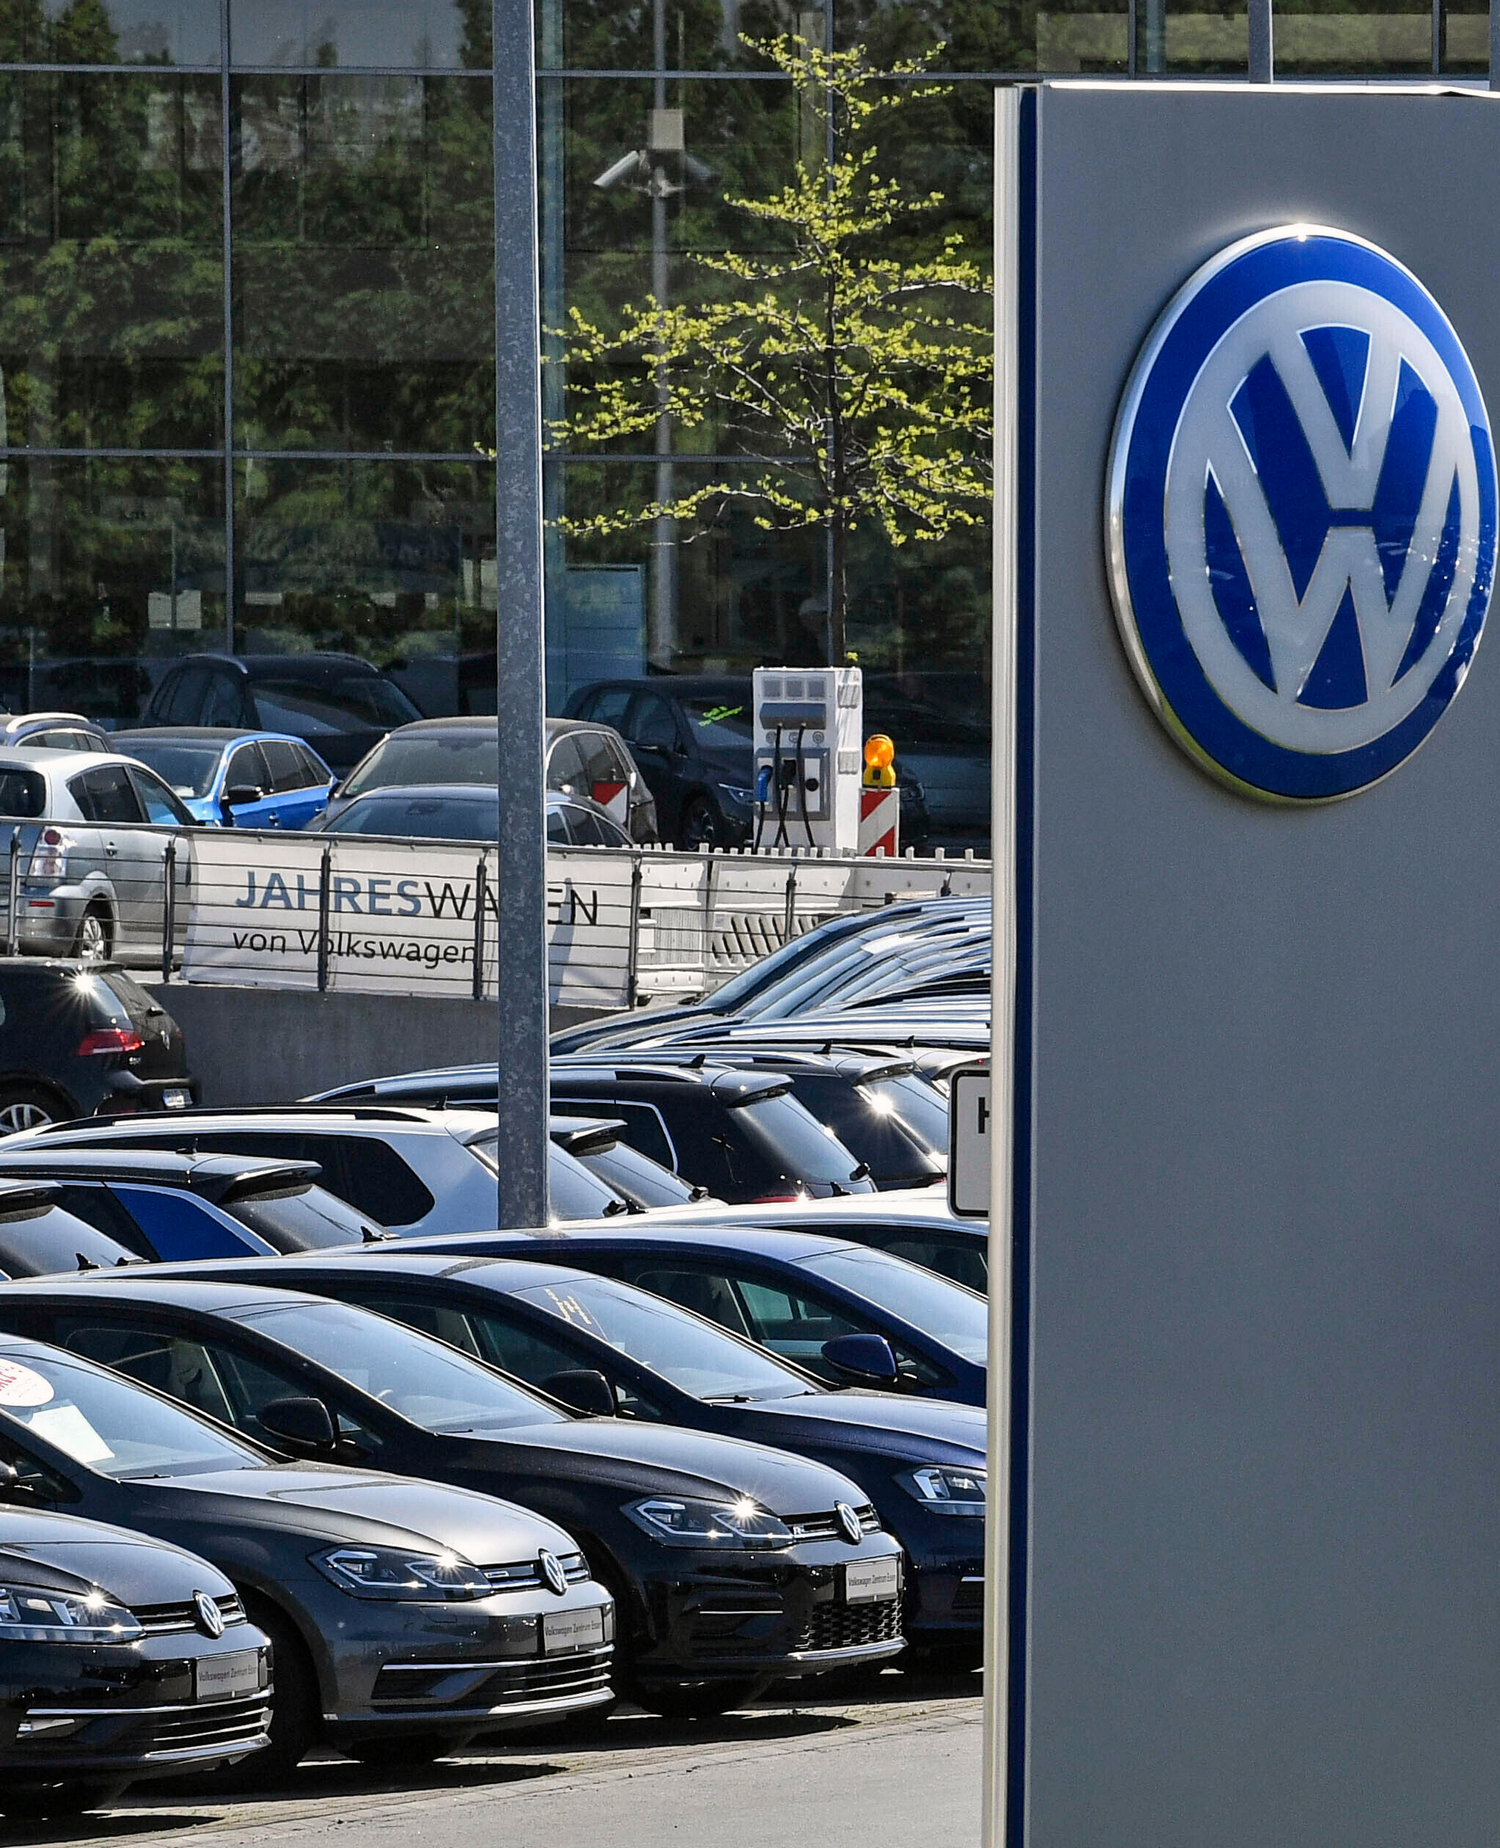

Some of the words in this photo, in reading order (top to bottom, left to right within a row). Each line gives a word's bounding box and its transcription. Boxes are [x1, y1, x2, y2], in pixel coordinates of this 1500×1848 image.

[1165, 280, 1479, 754] VW
[236, 870, 598, 926] JAHRESWAEN
[232, 931, 286, 954] von
